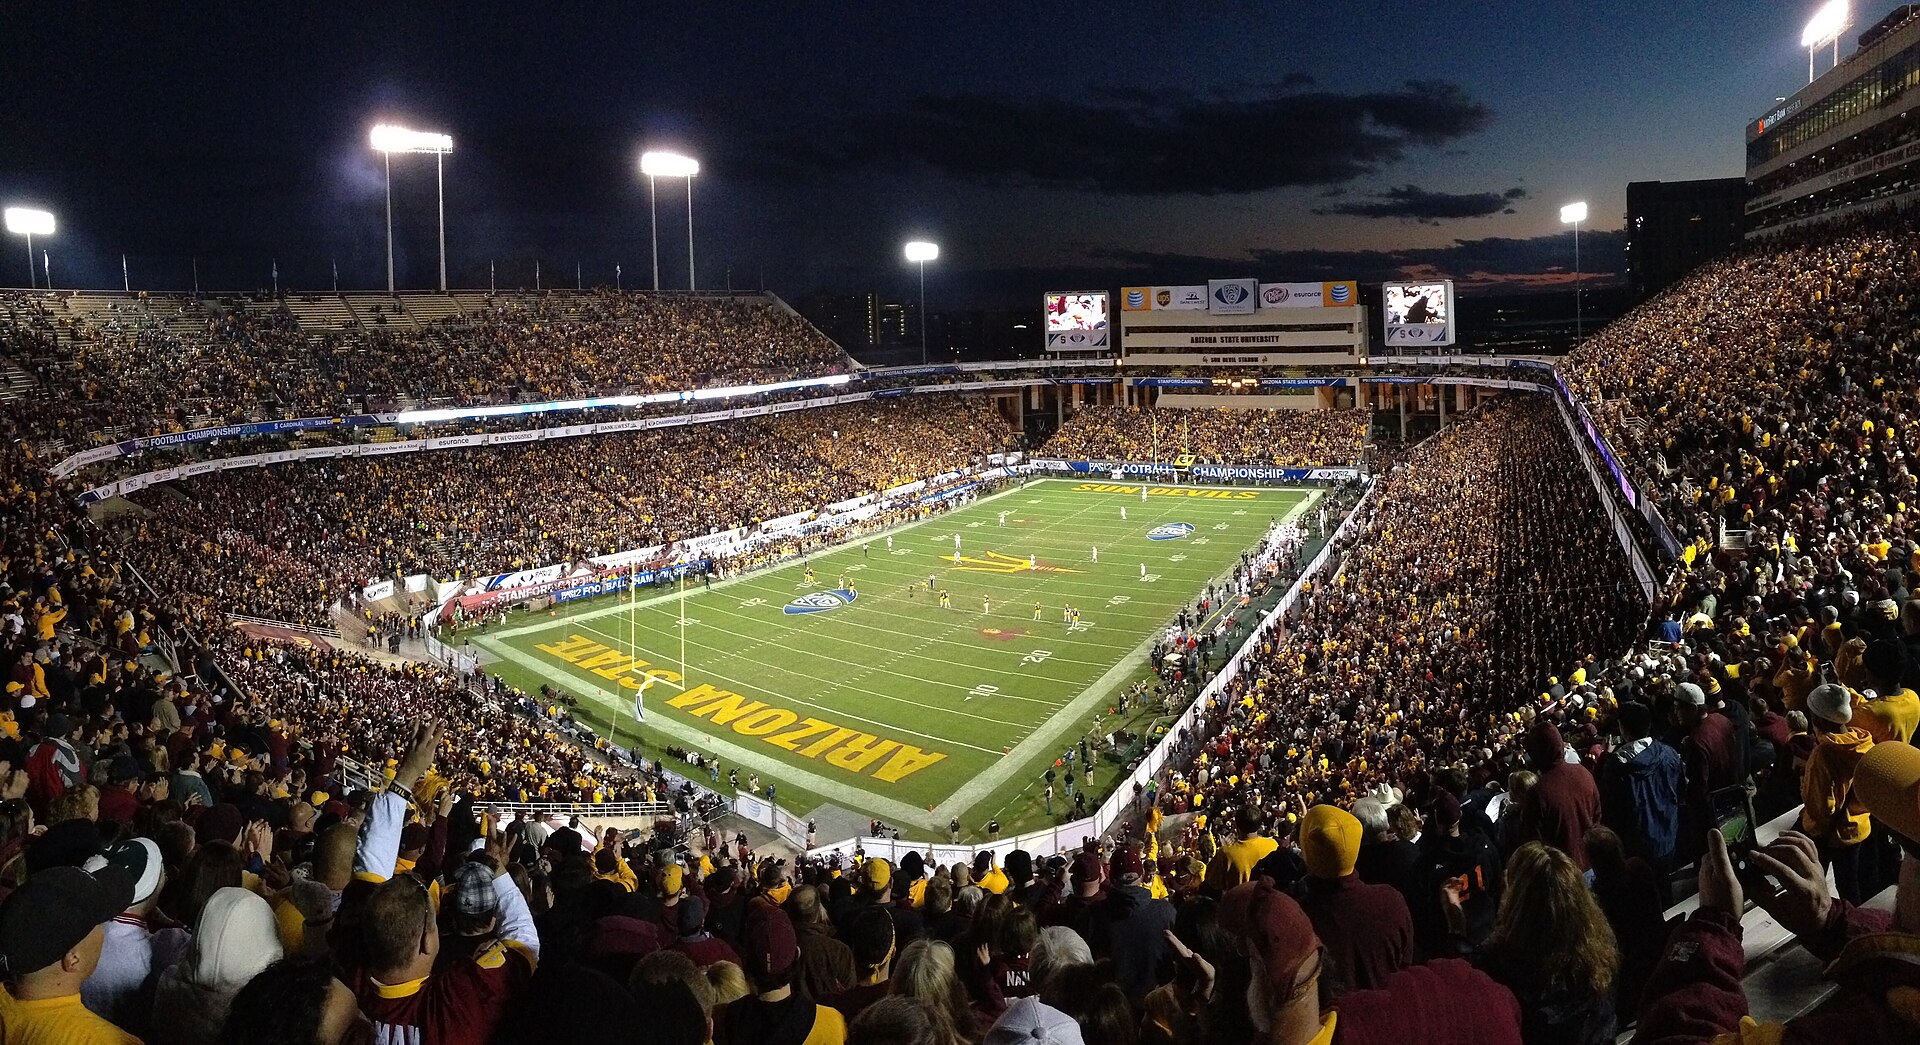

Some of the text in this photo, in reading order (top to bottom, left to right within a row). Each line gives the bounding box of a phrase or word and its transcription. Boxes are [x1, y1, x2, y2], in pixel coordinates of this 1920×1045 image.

[656, 418, 686, 426] CHAMPIONSHIP
[150, 434, 186, 448] FOOTBALL
[186, 428, 242, 441] CHAMPIONSHIP
[242, 426, 258, 434] 2013
[438, 438, 470, 446] esurance
[188, 464, 211, 473] esurance
[1193, 466, 1285, 479] CHAMPIONSHIP
[1072, 484, 1260, 499] SUN DEVILS
[696, 534, 728, 548] esurance
[1023, 650, 1053, 664] 20
[969, 684, 1000, 697] 10
[534, 634, 948, 782] STATE ARIZONA
